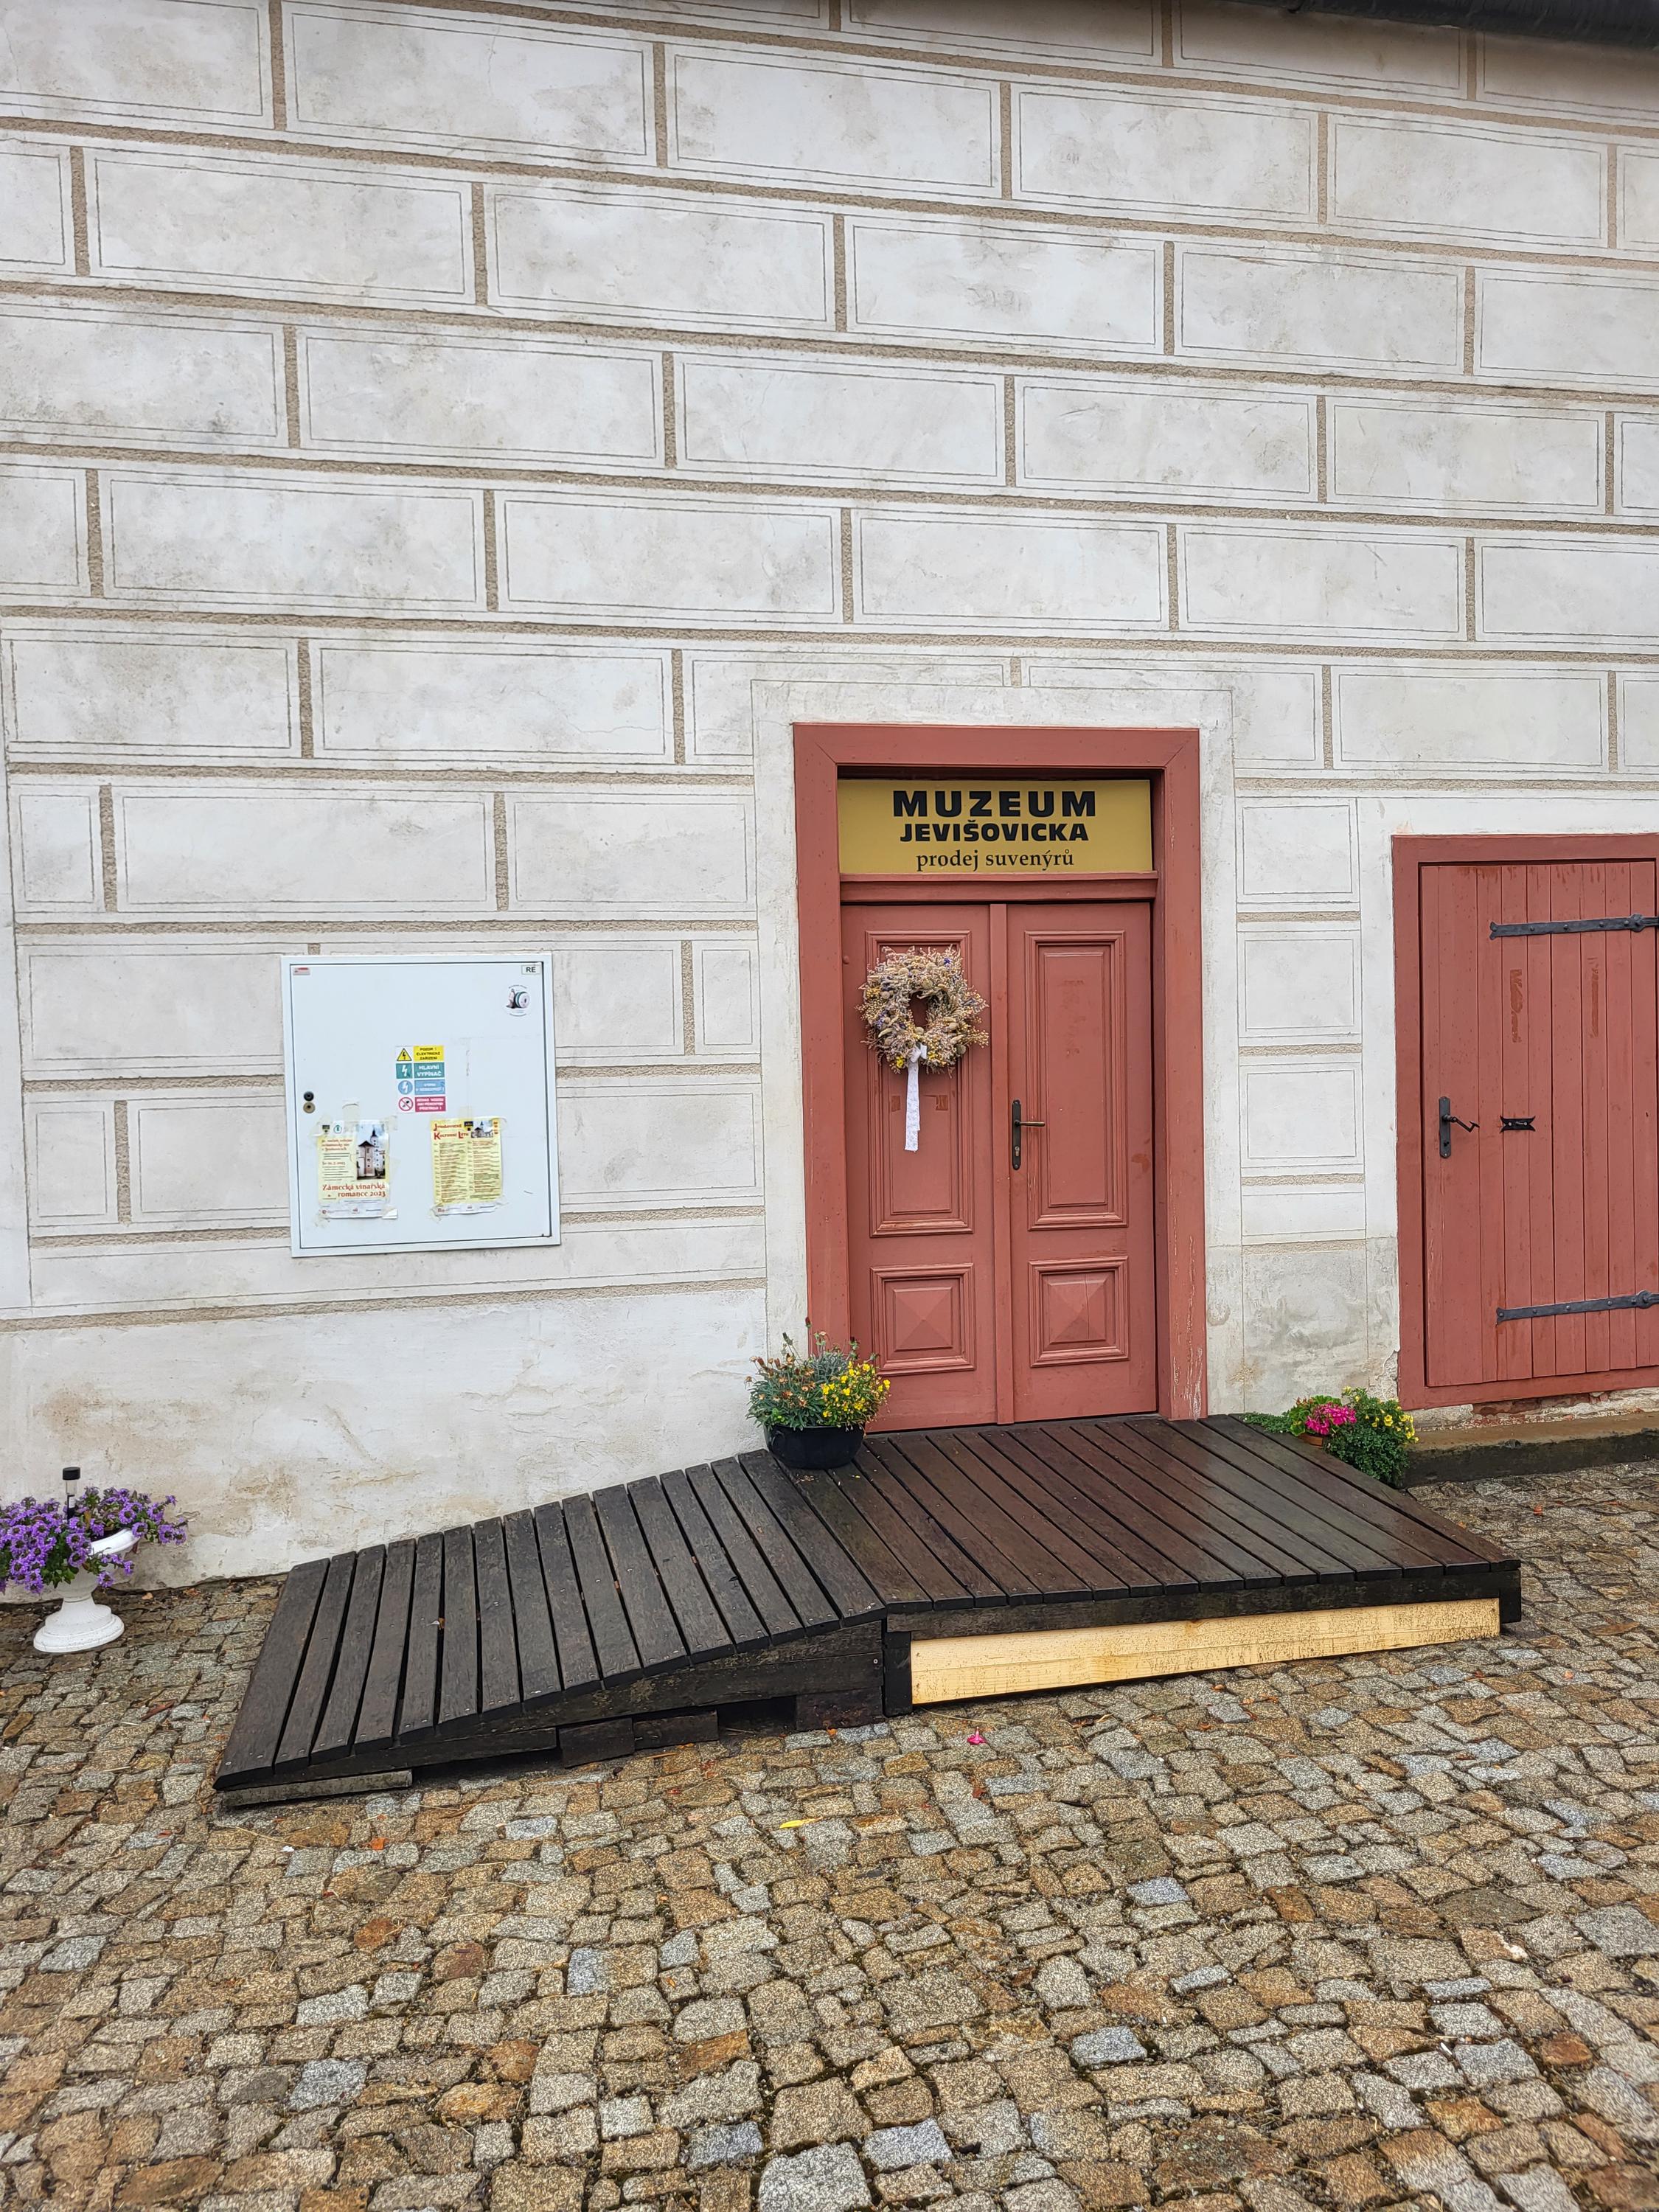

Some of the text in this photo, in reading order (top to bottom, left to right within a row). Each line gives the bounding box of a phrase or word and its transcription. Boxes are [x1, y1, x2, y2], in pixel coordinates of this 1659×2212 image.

[892, 790, 1096, 818] MUZEUM
[900, 819, 1090, 842] JEVIŠOVICKA
[916, 849, 1074, 872] prodej suvenýrů
[322, 1183, 354, 1192] Zámecká
